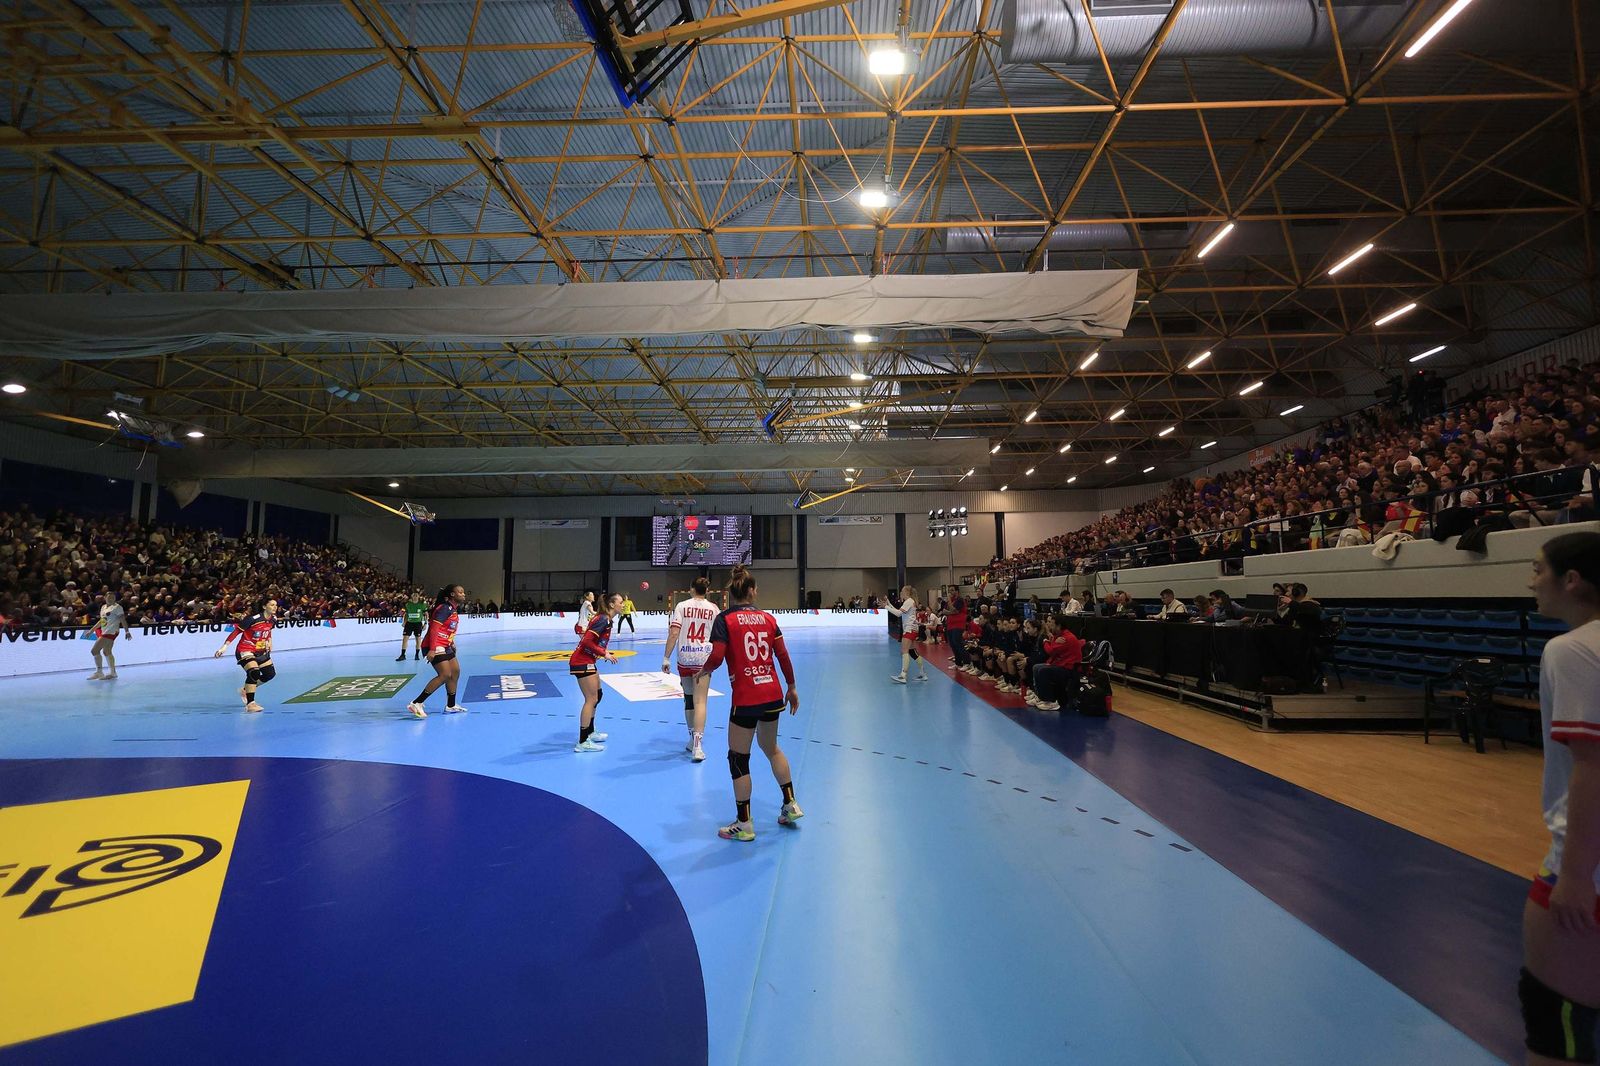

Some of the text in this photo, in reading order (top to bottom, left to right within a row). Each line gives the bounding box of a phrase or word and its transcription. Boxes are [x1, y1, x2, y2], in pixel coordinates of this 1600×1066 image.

[688, 533, 695, 541] 0
[709, 533, 715, 541] 1
[683, 606, 714, 620] LEITNER
[736, 613, 767, 626] ERAUSKIN
[687, 621, 707, 643] 44
[680, 645, 704, 653] Allianz
[743, 631, 770, 661] 65
